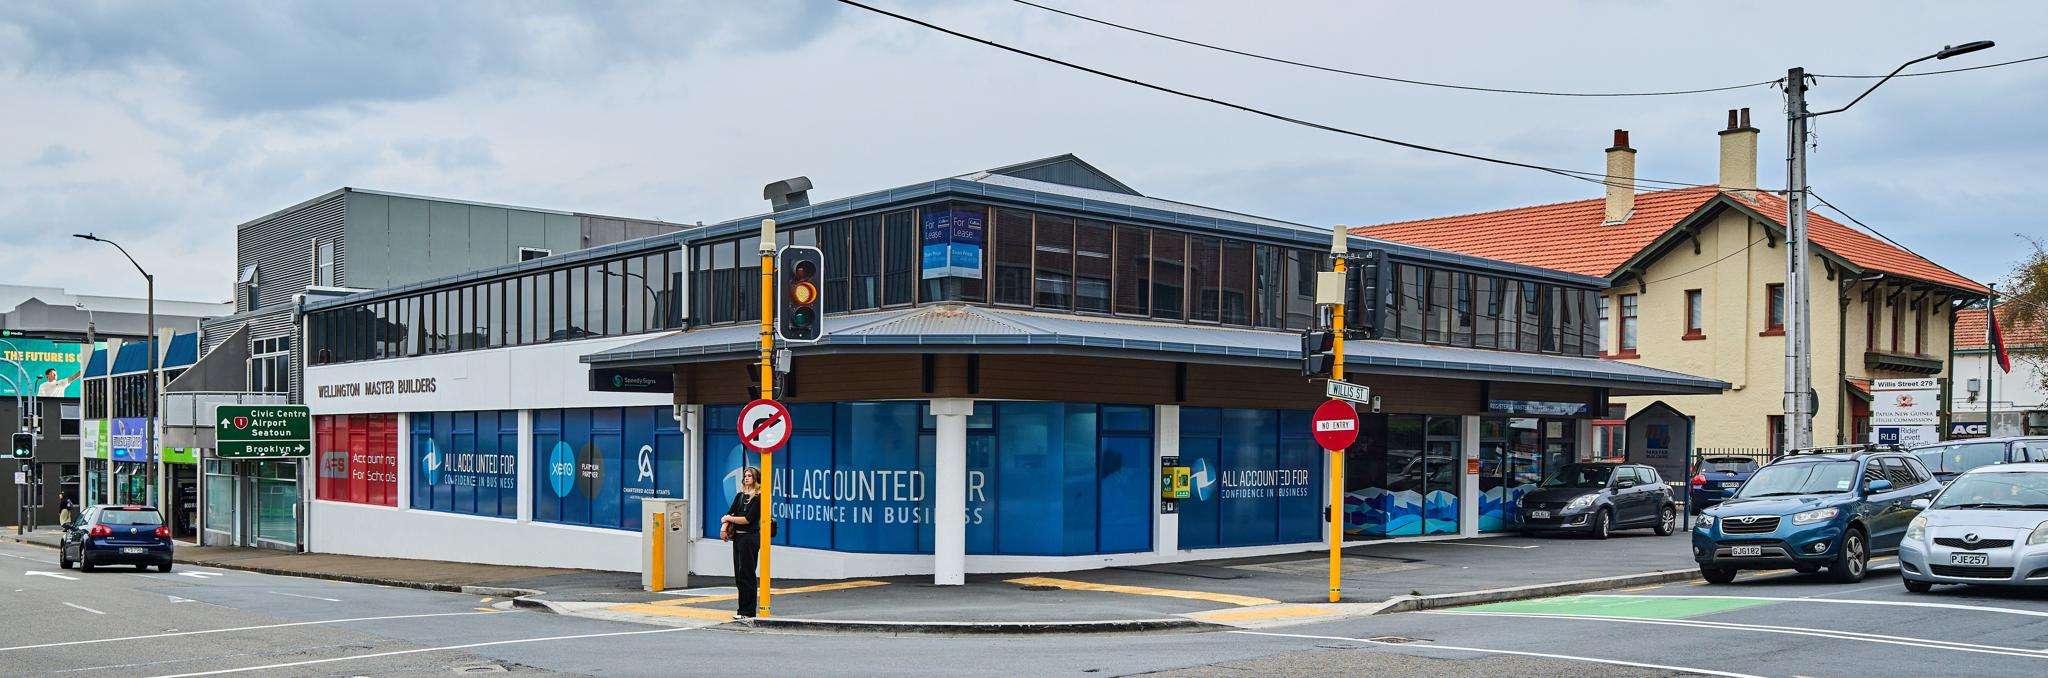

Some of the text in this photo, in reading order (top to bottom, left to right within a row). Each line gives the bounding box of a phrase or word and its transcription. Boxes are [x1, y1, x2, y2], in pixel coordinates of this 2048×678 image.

[925, 221, 935, 230] For
[954, 217, 965, 227] For
[925, 231, 943, 240] Lease
[954, 228, 974, 239] Lease
[4, 351, 23, 361] THE
[25, 351, 63, 363] FUTURE
[65, 353, 75, 363] IS
[318, 377, 437, 398] WELLINGTON MASTER BUILDERS
[1333, 384, 1364, 399] WILLIS ST
[250, 410, 307, 418] Civic Centre
[239, 418, 243, 426] 1
[251, 419, 287, 428] Airport
[1321, 421, 1349, 430] NO ENTRY
[251, 429, 292, 437] Seatoun
[1951, 424, 1987, 435] ACE
[1880, 433, 1897, 441] RLB
[246, 445, 291, 455] Brooklyn
[353, 453, 396, 467] Accountng
[500, 455, 515, 475] FOR
[352, 469, 365, 480] For
[552, 463, 573, 476] xero
[444, 473, 514, 489] CONFIDENCE IN BUSNESS
[1222, 468, 1309, 488] ALL ACCOUNTED FOR
[772, 468, 925, 502] ALL ACCOUNTED
[1222, 487, 1309, 499] CONFIDENCE IN BUSINESS
[772, 502, 984, 525] CONFIDENCE IN BUSISS
[1951, 555, 1987, 565] PJE257
